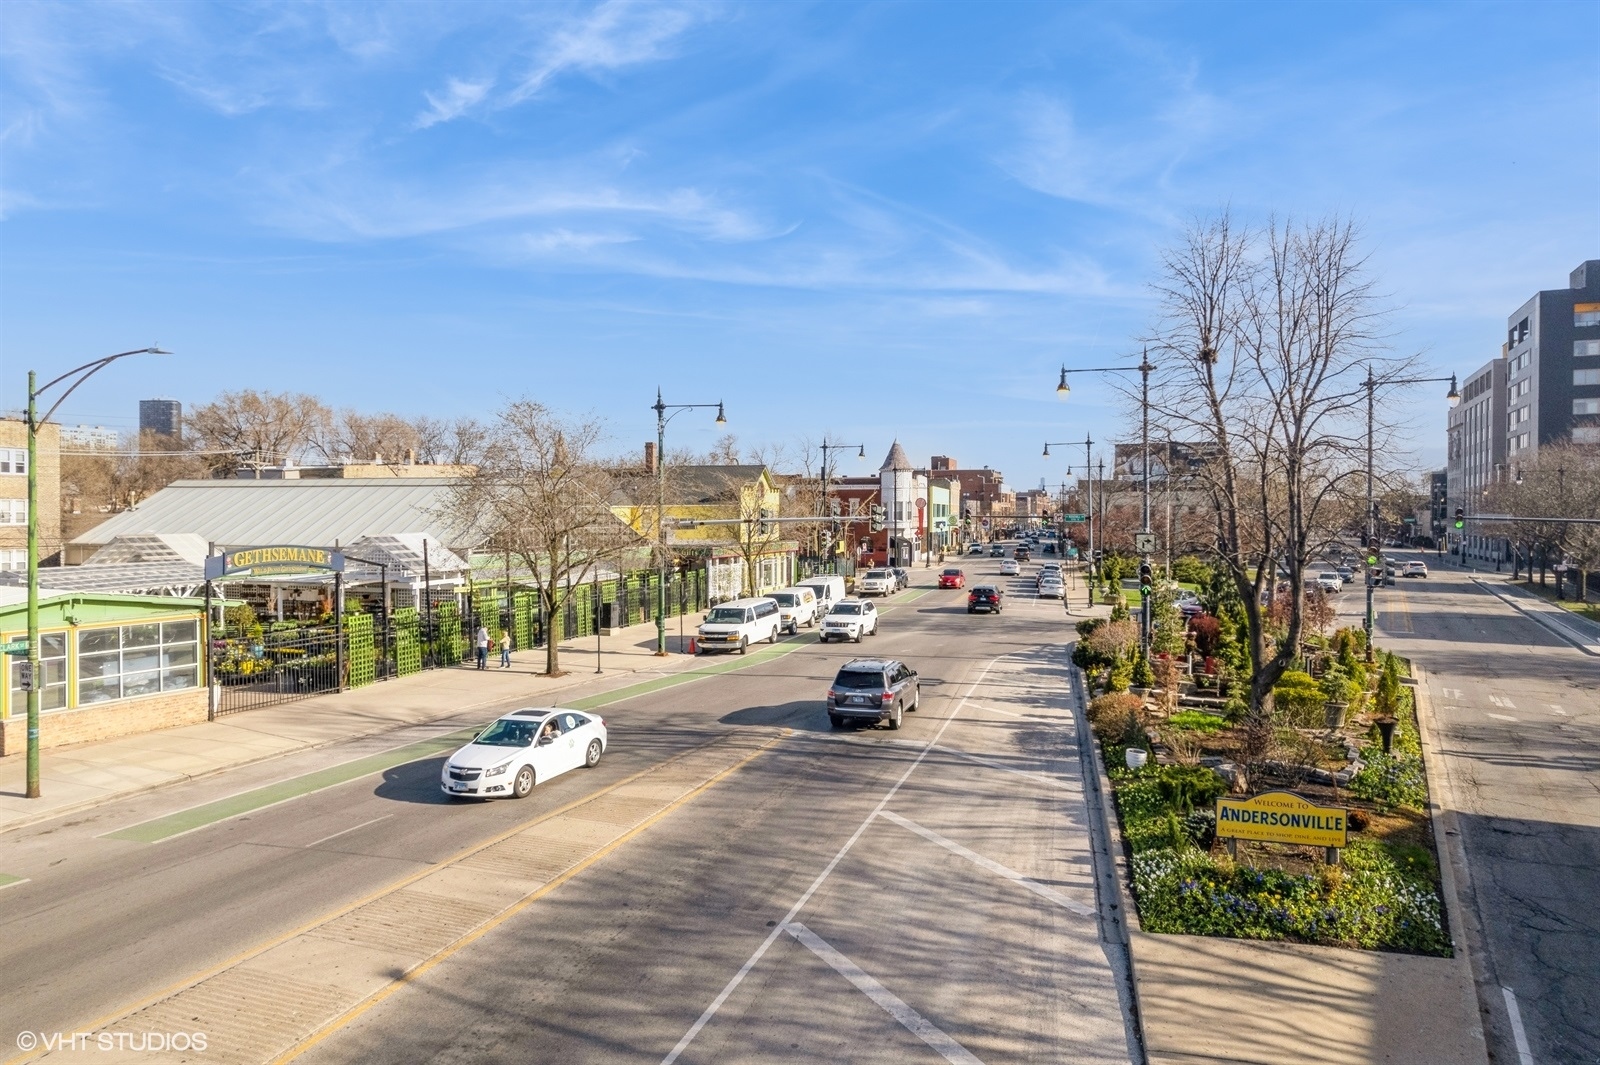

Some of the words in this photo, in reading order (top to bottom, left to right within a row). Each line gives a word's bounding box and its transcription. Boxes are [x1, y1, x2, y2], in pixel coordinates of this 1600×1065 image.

[233, 547, 325, 567] GETHSEMANE
[21, 664, 32, 672] ONE
[1253, 799, 1294, 809] WELCOME
[1220, 806, 1343, 831] ANDERSONVILLE
